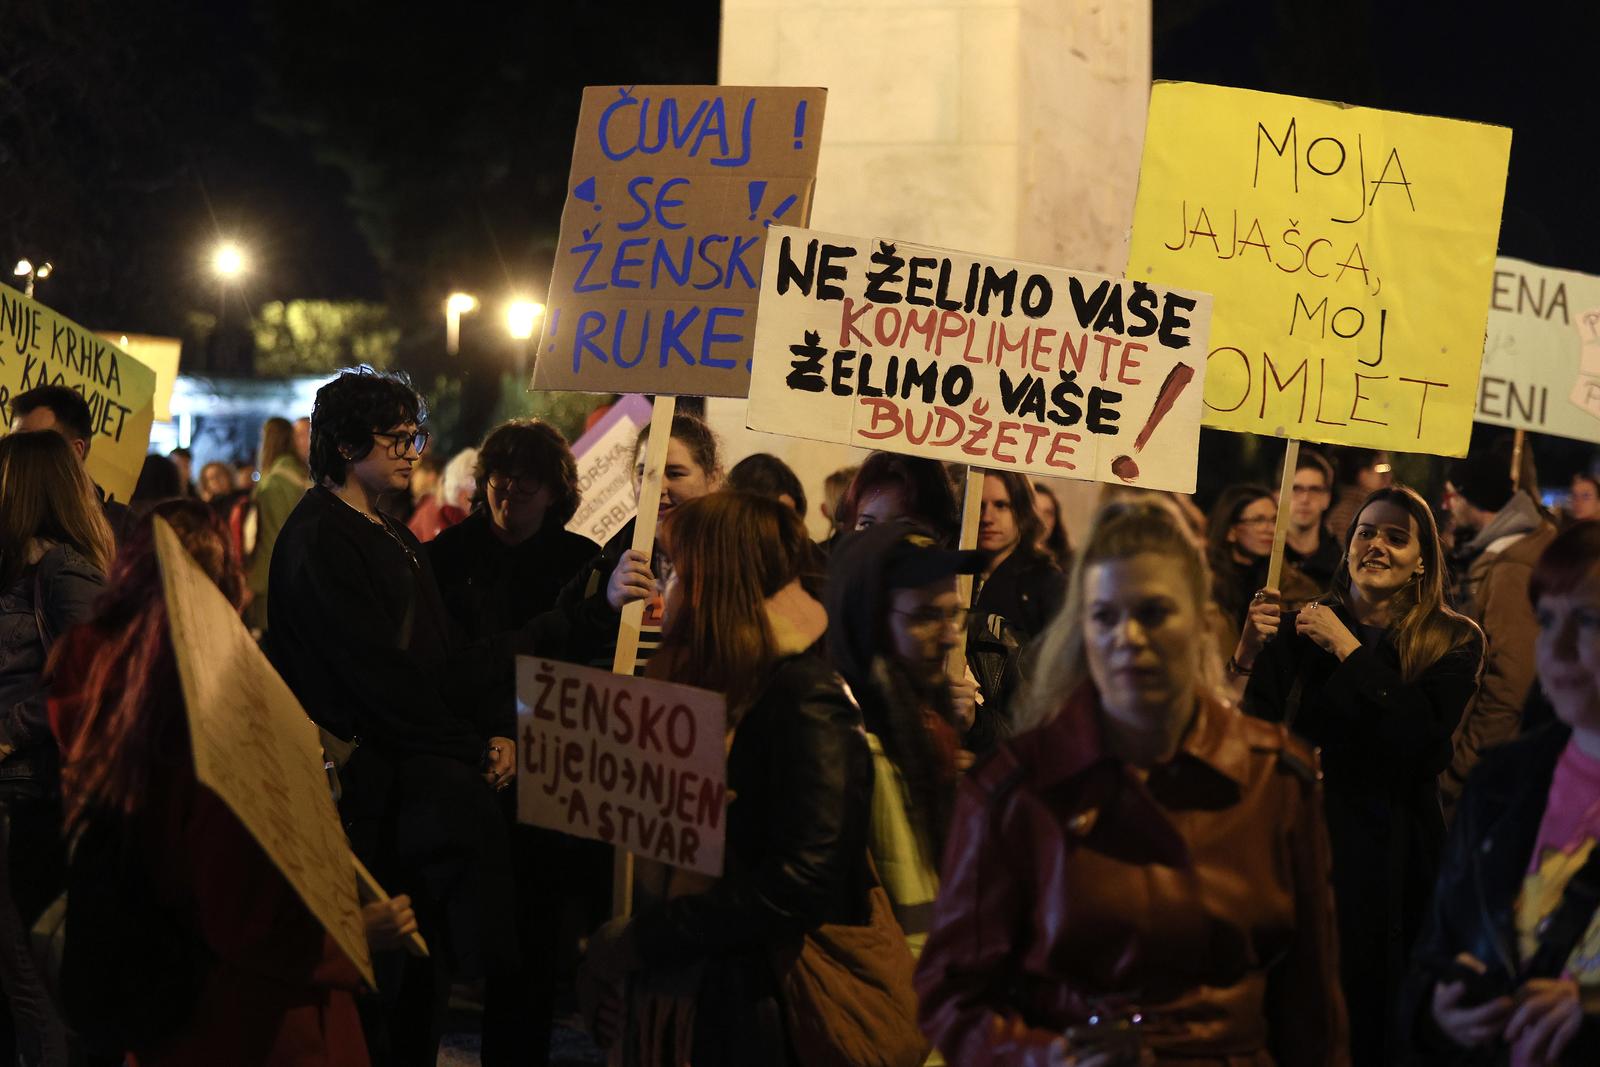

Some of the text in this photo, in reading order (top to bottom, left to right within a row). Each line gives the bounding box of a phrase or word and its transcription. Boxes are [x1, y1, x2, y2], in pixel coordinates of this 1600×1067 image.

[598, 86, 756, 167] ČUVAJ
[617, 176, 690, 232] SE
[1253, 117, 1415, 223] MOJA
[570, 223, 760, 293] ŽENSK
[1164, 200, 1381, 296] JAJAŠCA,
[776, 235, 1197, 349] NE ŽELIMO VAŠE
[1491, 270, 1570, 326] ENA
[50, 320, 121, 396] KRHKA
[838, 297, 1149, 386] KOMPLIMENTE
[1289, 293, 1387, 368] MOJ
[786, 328, 1123, 436] ŽELIMO VAŠE
[1202, 346, 1449, 439] OMLET
[1479, 375, 1548, 425] ENI
[857, 397, 1082, 470] BUDŽETE
[533, 661, 697, 759] ŽENSKO
[597, 801, 700, 866] STVAR
[639, 761, 726, 830] NJEN
